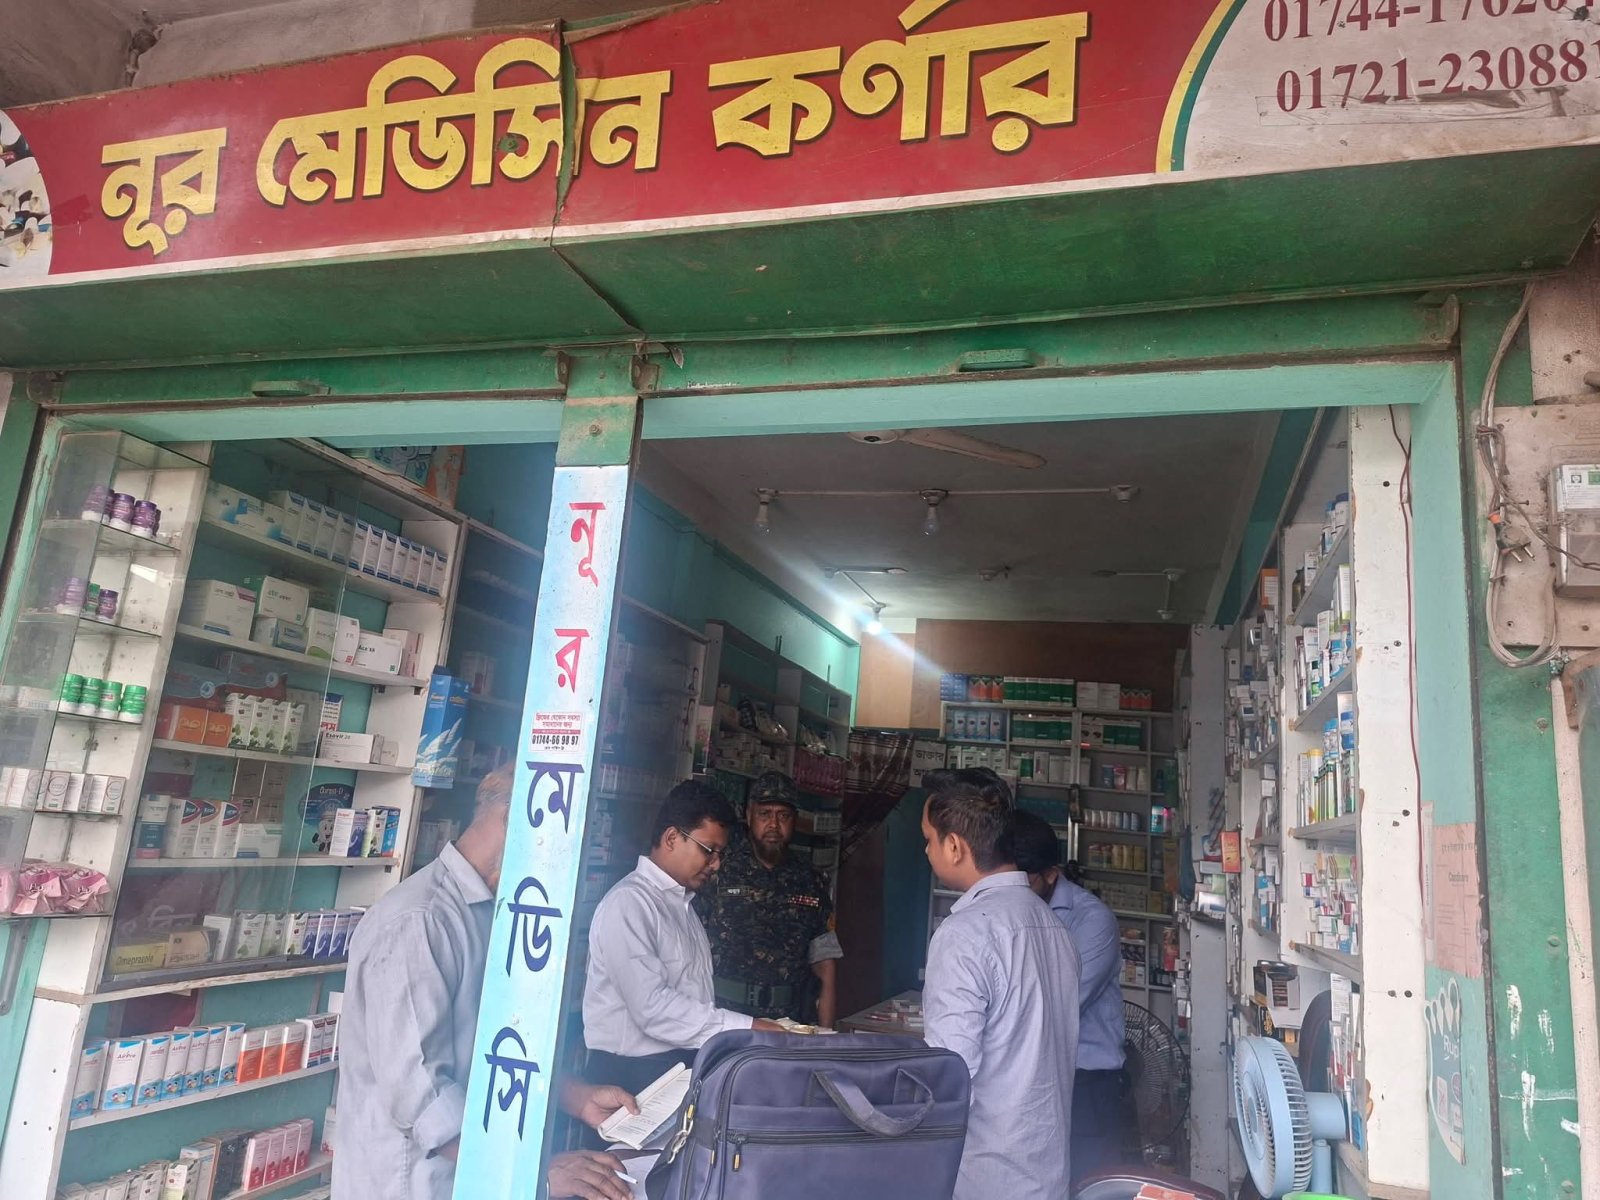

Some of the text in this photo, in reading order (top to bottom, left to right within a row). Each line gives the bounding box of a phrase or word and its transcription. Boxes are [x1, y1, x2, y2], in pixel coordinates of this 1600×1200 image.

[1264, 0, 1600, 42] 01744-17
[101, 0, 1088, 256] নূর মেডিসিন কর্ণার
